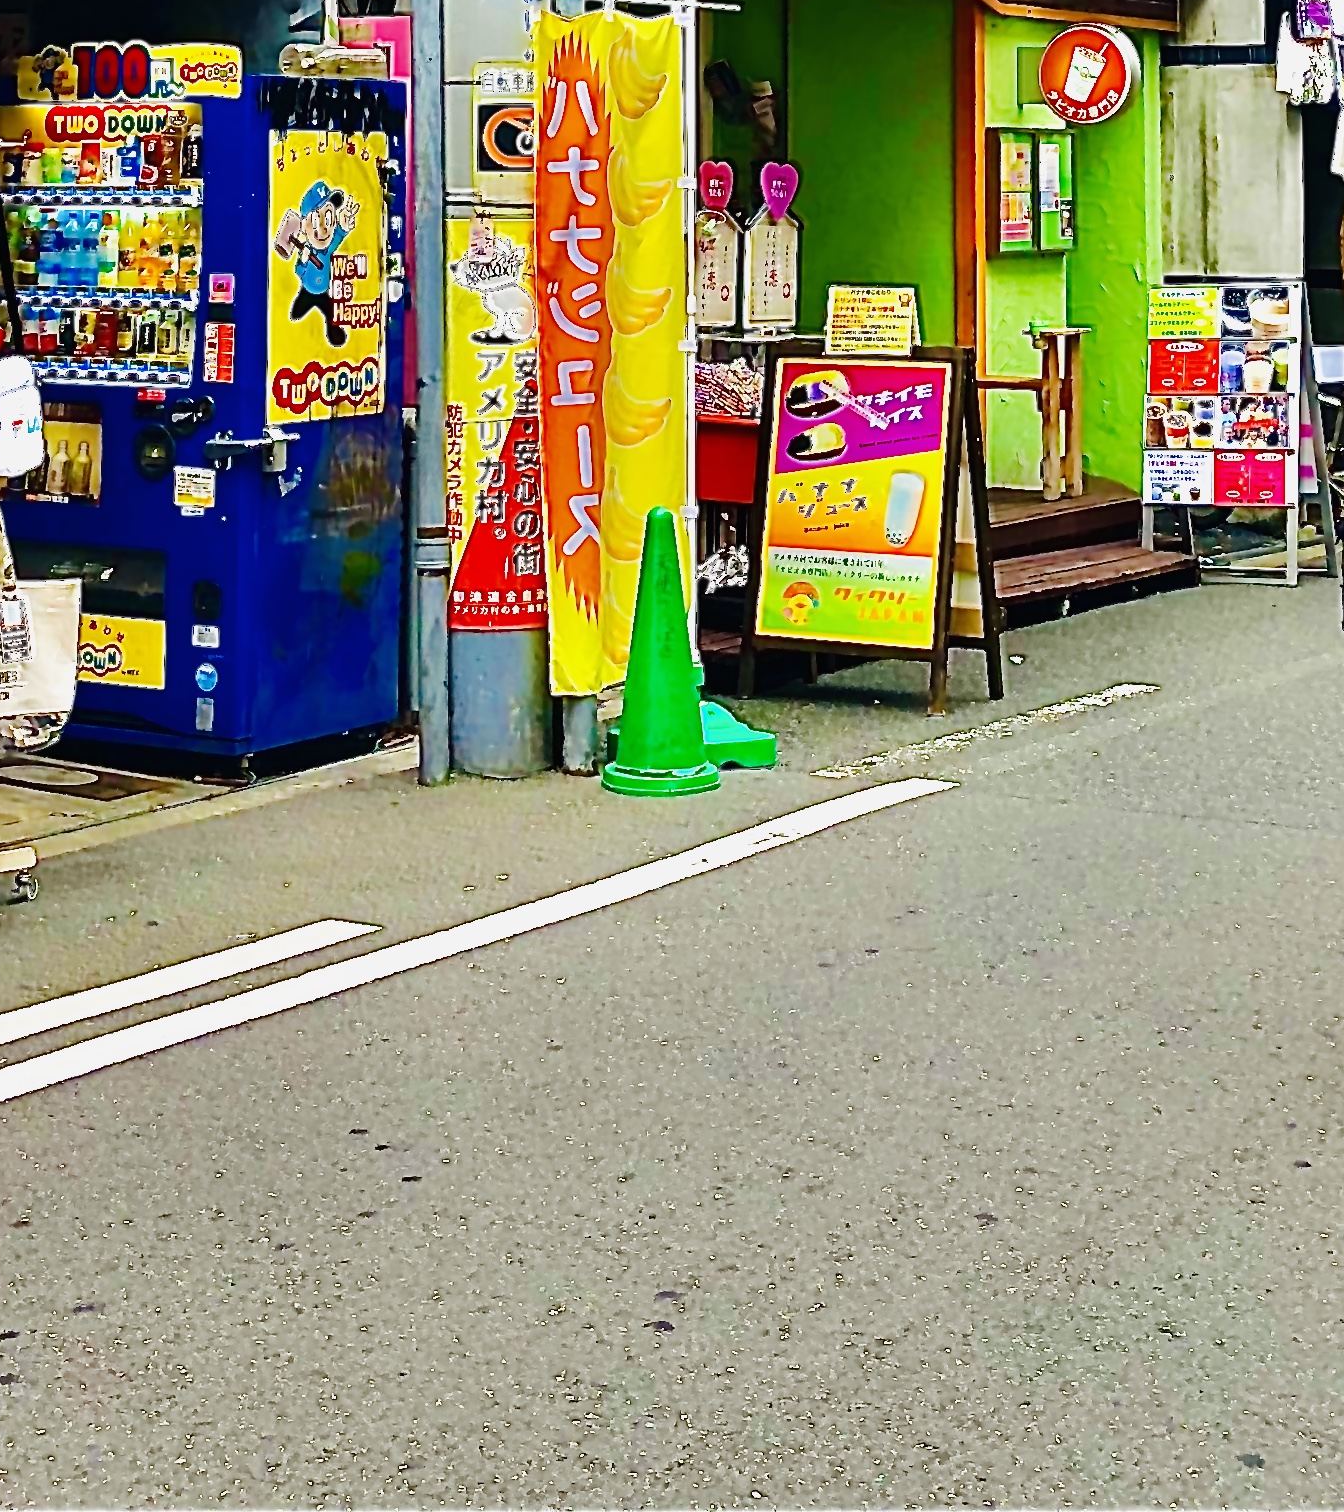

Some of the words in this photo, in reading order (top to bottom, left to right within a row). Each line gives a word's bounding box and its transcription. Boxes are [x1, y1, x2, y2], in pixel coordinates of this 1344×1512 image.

[1045, 88, 1120, 120] タピオカ専門店
[53, 112, 99, 135] TWO
[107, 112, 167, 135] DOWN
[332, 280, 353, 299] Be
[332, 299, 381, 327] Happy!
[324, 364, 376, 403] DOWN
[474, 351, 507, 540] アメリカ村。
[445, 403, 464, 544] 防犯カメラ作動中
[512, 350, 541, 576] 安全・安心の街
[78, 649, 118, 670] OWN
